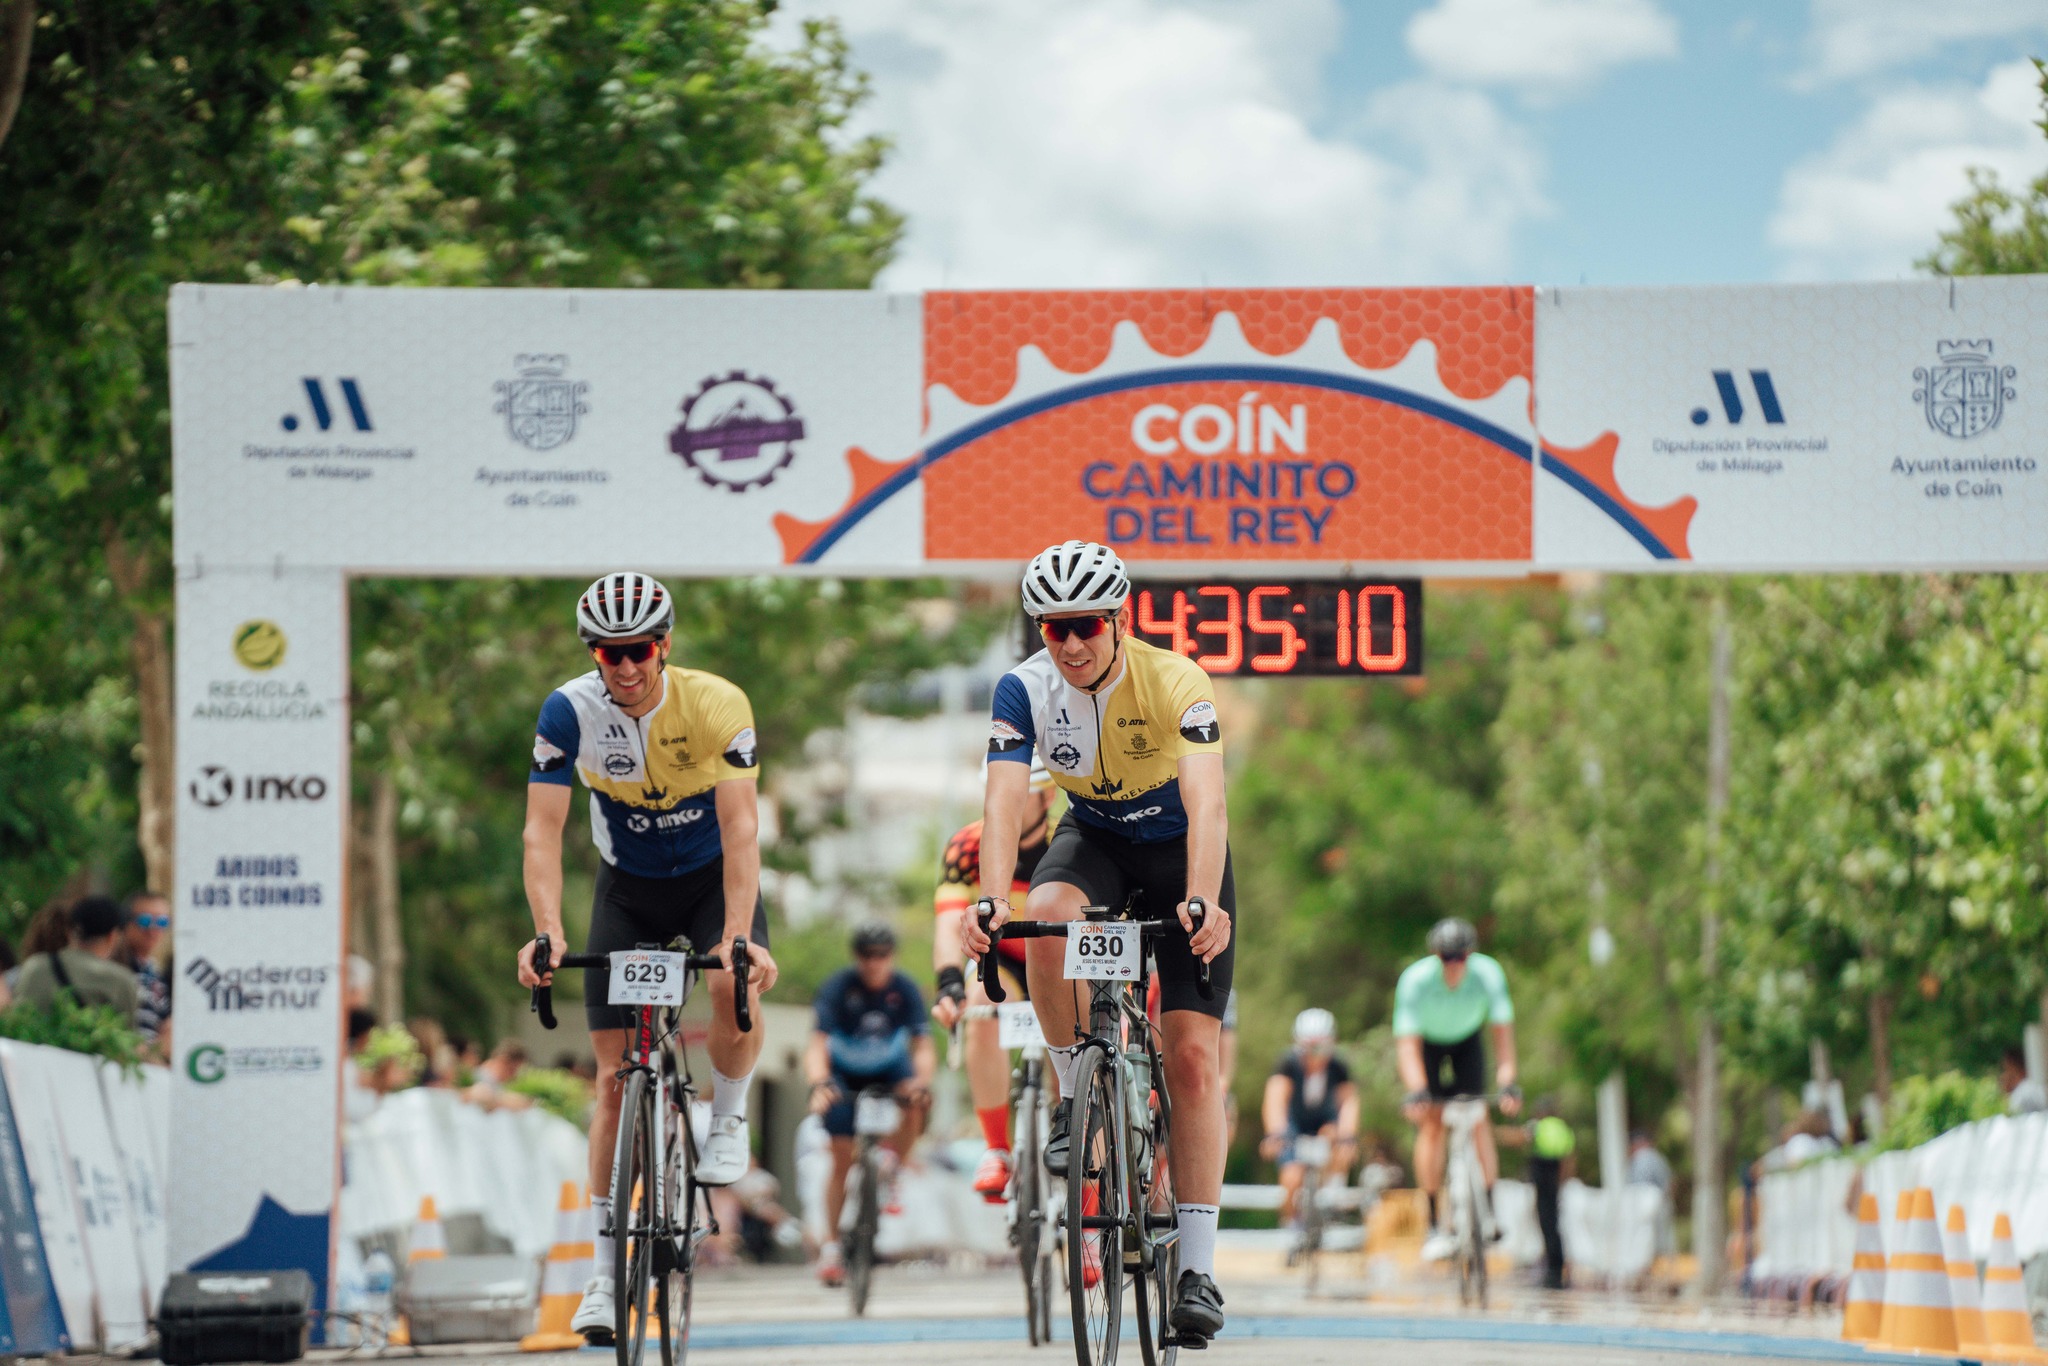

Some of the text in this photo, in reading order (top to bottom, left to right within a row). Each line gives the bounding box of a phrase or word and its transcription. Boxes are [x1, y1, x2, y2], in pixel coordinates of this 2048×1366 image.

[1131, 391, 1307, 455] COÍN
[1746, 437, 1829, 452] Provincial
[1697, 457, 1717, 472] de
[1891, 456, 2037, 475] Ayuntamiento
[475, 467, 610, 485] Ayuntamiento
[1082, 460, 1356, 500] CAMINITO
[1924, 479, 1951, 497] de
[1107, 507, 1334, 543] DEL REY
[1122, 586, 1406, 672] 4:35:10
[208, 681, 309, 698] RECICLA
[193, 885, 321, 906] LOS COINOS
[1079, 936, 1123, 957] 630
[624, 963, 666, 983] 629
